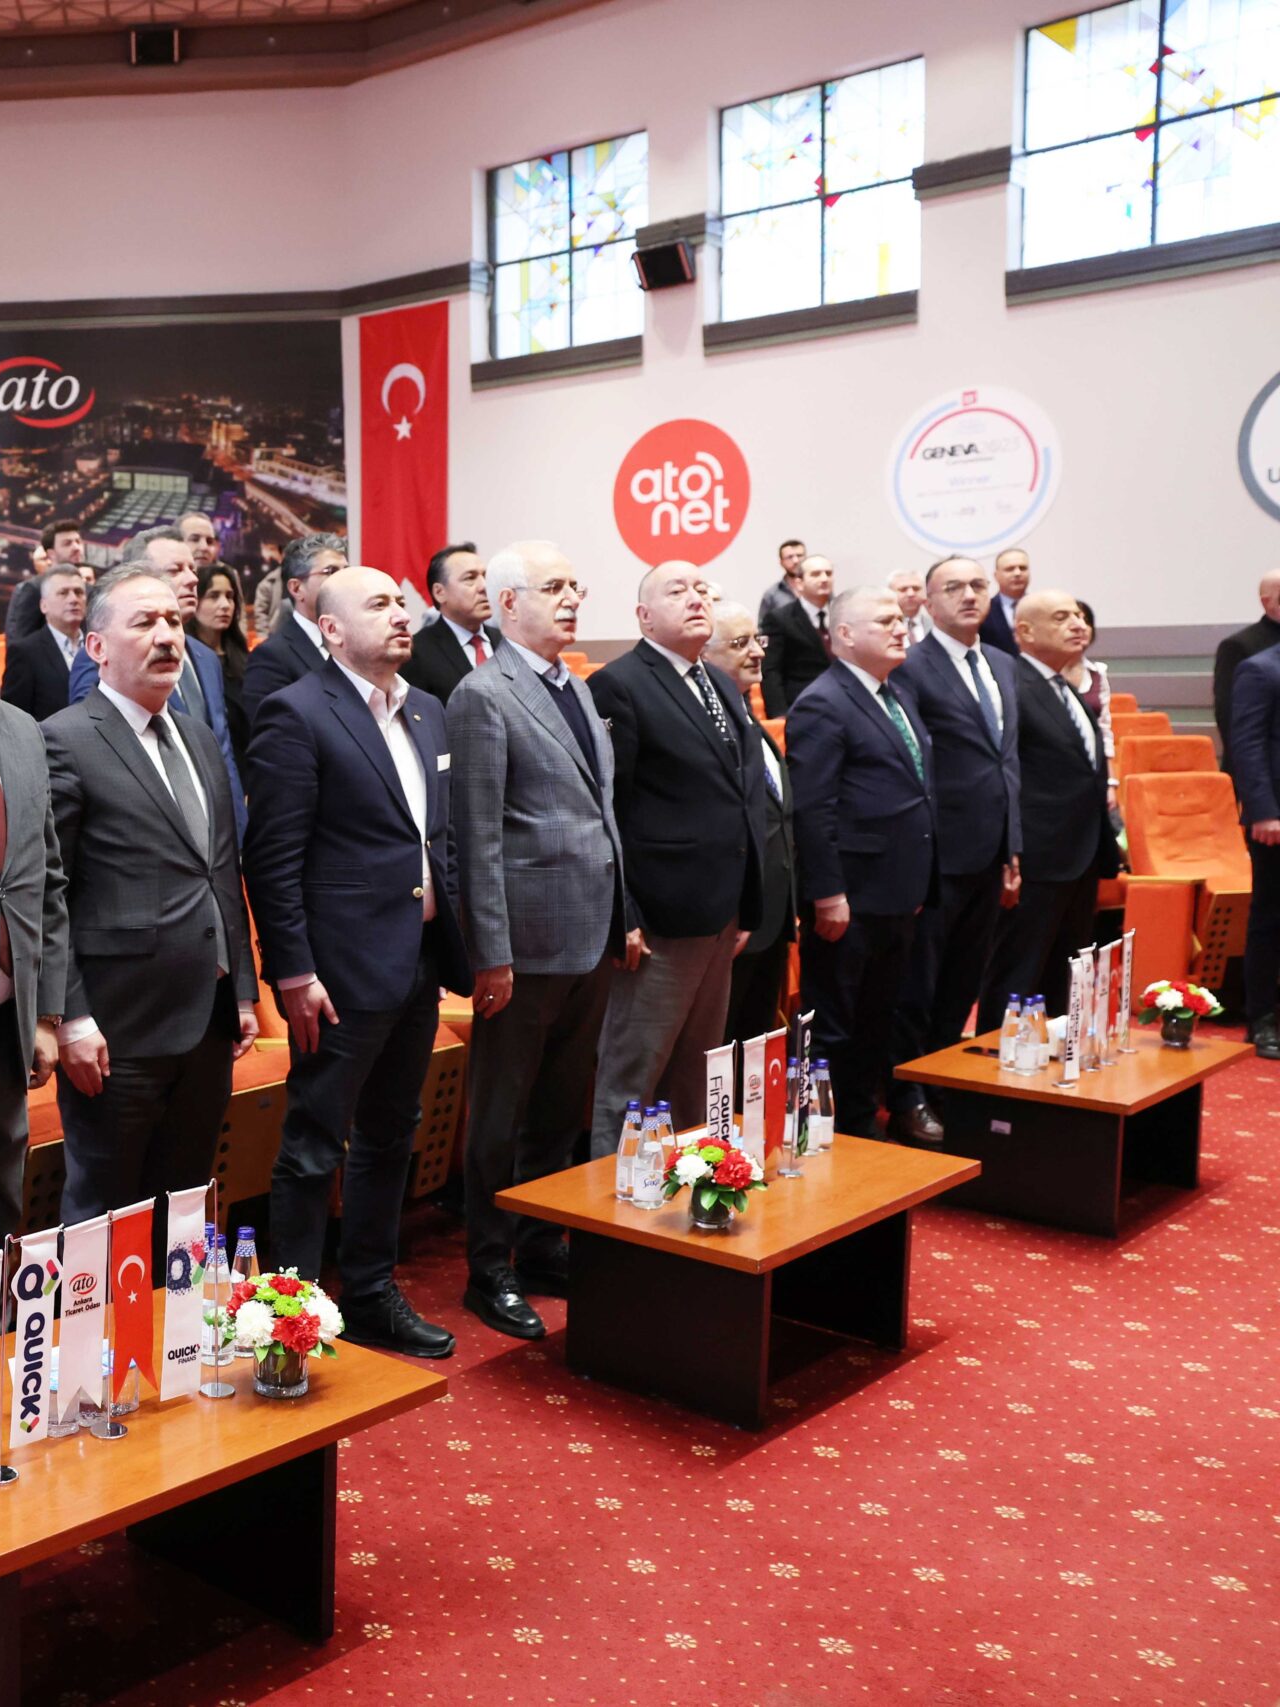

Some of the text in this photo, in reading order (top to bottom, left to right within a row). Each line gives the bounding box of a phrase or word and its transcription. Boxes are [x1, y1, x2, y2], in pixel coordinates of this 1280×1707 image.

[922, 443, 979, 460] GENEVA
[630, 461, 712, 504] ato
[651, 485, 731, 536] net
[73, 1276, 94, 1292] ato
[65, 1302, 101, 1317] Ticaret Odası
[73, 1297, 93, 1307] Ankara
[167, 1345, 197, 1361] QUICK
[178, 1354, 197, 1365] FINANS
[20, 1312, 45, 1420] QUICK
